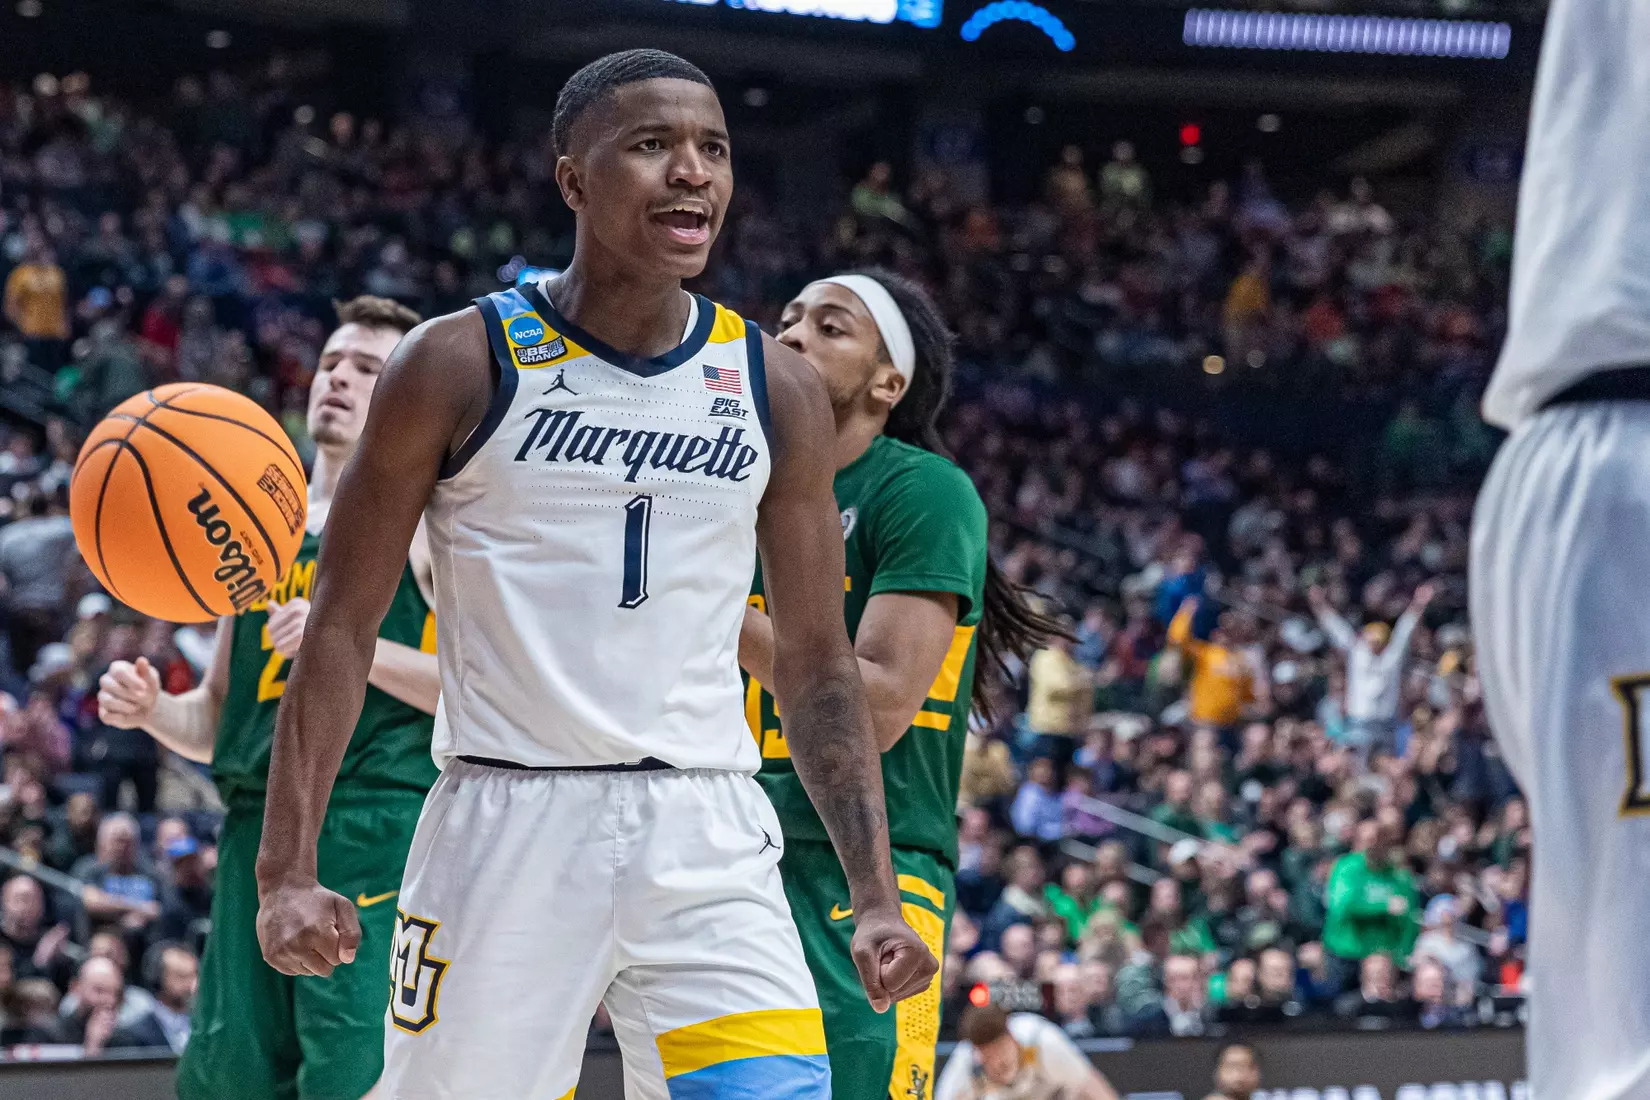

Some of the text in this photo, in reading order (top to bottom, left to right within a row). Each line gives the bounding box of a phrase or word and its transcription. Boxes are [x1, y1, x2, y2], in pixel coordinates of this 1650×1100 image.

[514, 328, 544, 339] NCAA
[520, 346, 565, 363] CHANGE
[710, 405, 749, 417] EAST
[714, 397, 740, 408] BIG
[514, 408, 759, 483] Marquette
[187, 487, 267, 612] Wilson
[617, 494, 652, 609] 1
